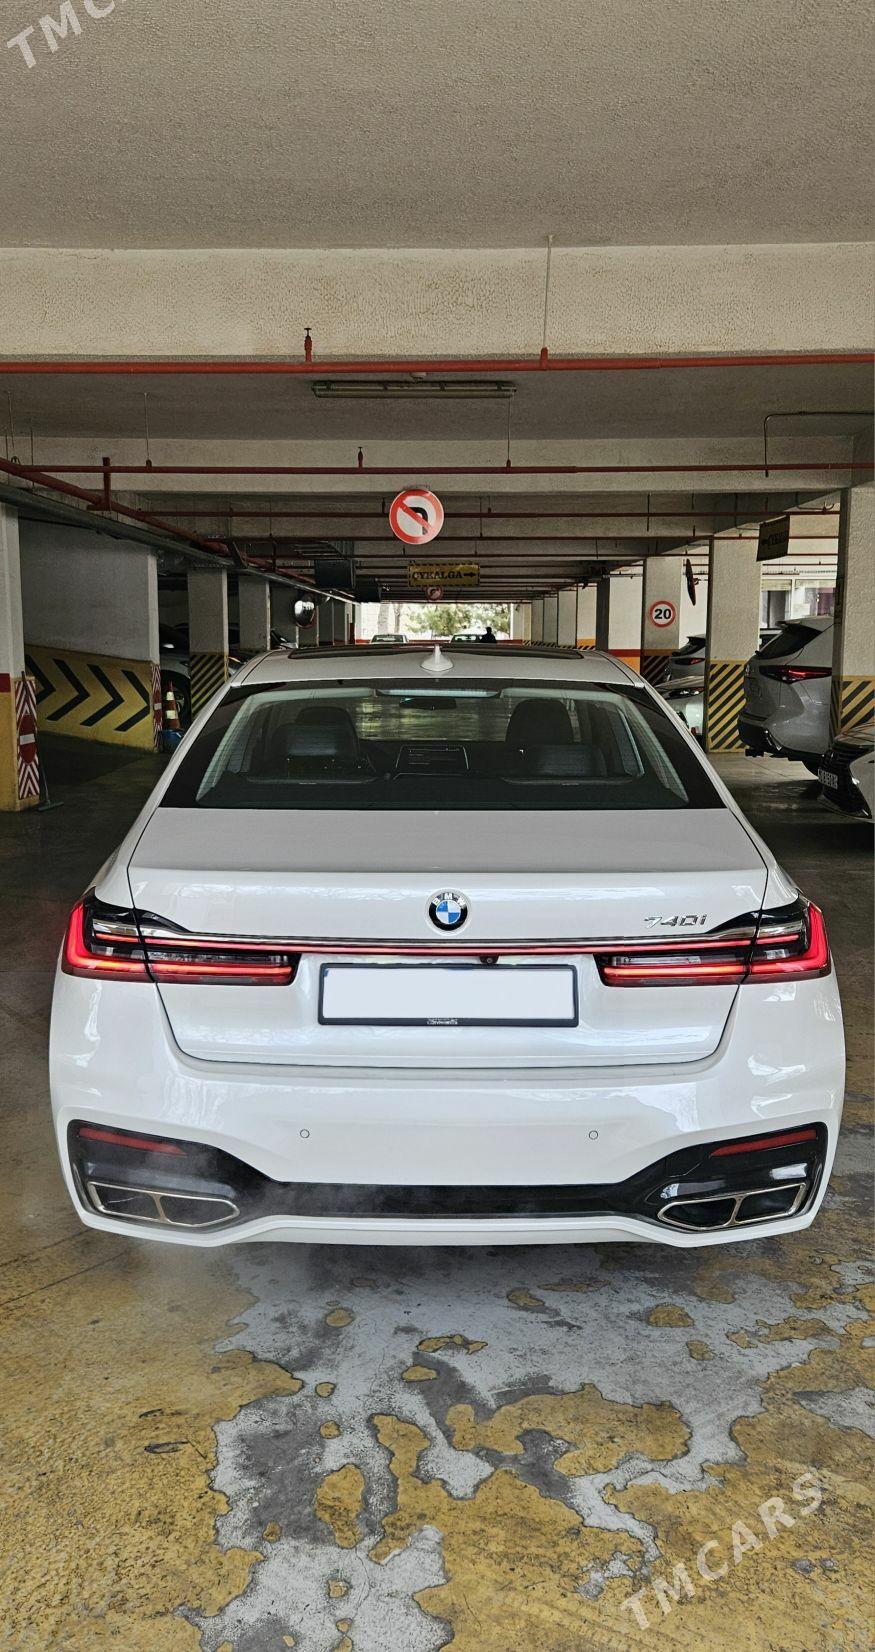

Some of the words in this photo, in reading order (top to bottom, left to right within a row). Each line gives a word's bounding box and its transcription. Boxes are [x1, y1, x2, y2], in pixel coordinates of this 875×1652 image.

[654, 608, 672, 620] 20
[432, 892, 467, 907] BMW
[643, 914, 708, 929] 740i
